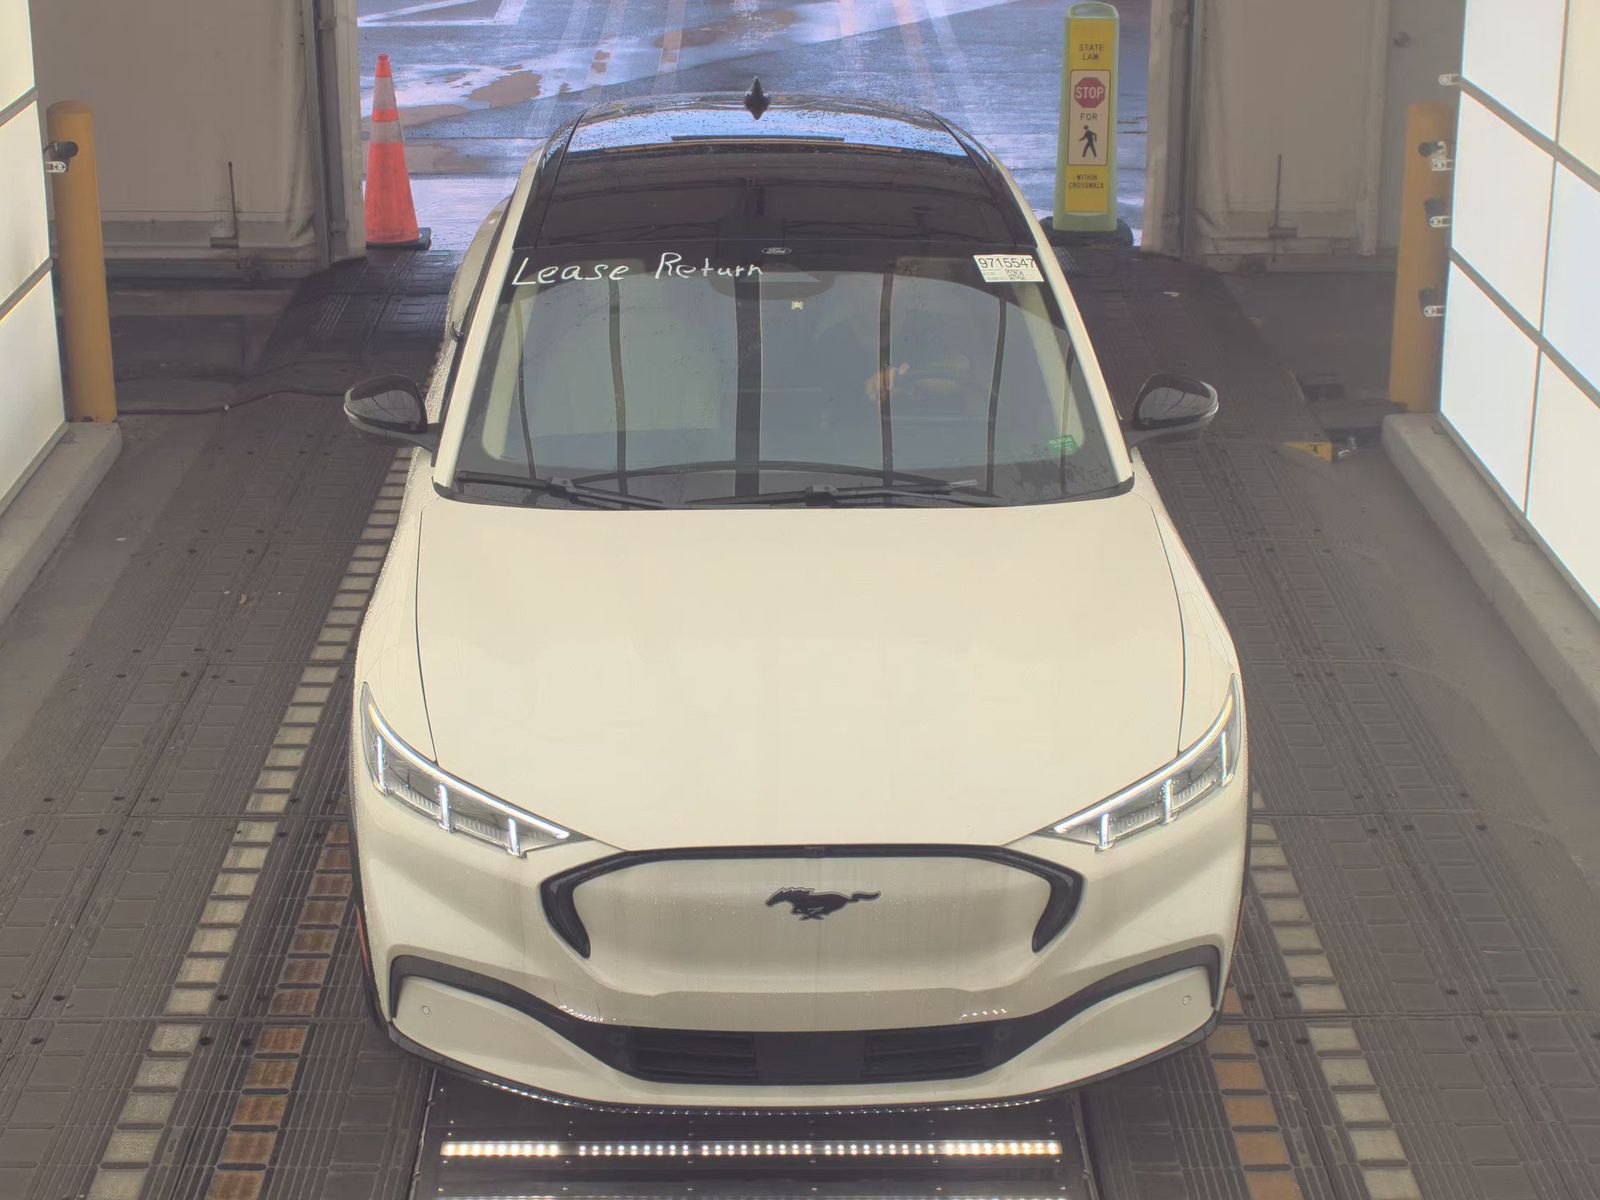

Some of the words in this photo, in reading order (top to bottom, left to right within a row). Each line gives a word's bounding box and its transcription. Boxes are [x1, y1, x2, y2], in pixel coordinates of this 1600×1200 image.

[1079, 43, 1104, 51] STATE
[1082, 53, 1099, 61] LAW
[1075, 86, 1104, 99] STOP
[1080, 112, 1098, 121] FOR
[978, 257, 1034, 269] 9715547
[512, 257, 629, 285] Lease
[655, 252, 763, 280] Return
